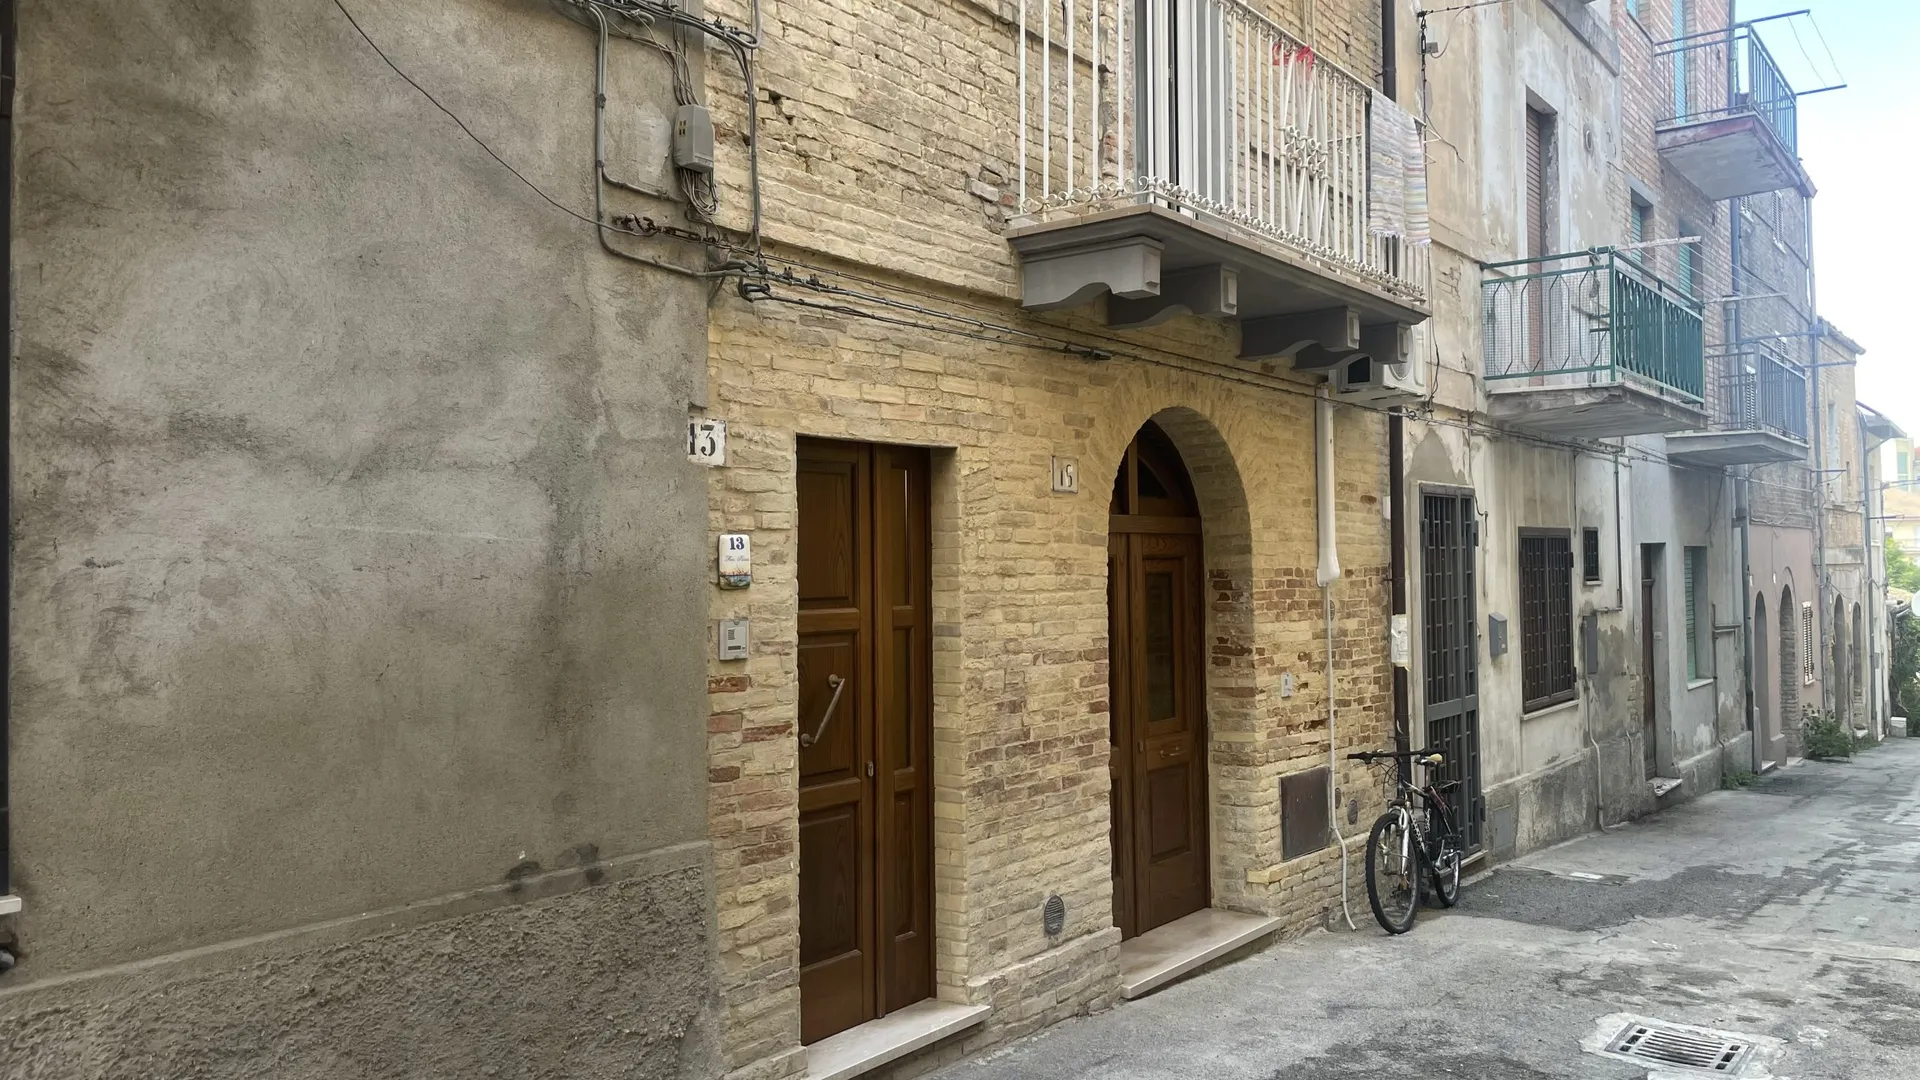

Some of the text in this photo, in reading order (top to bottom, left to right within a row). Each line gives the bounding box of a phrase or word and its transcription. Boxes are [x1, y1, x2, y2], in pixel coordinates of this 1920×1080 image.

[689, 423, 716, 457] 13
[1060, 464, 1073, 488] 15
[730, 536, 745, 551] 13
